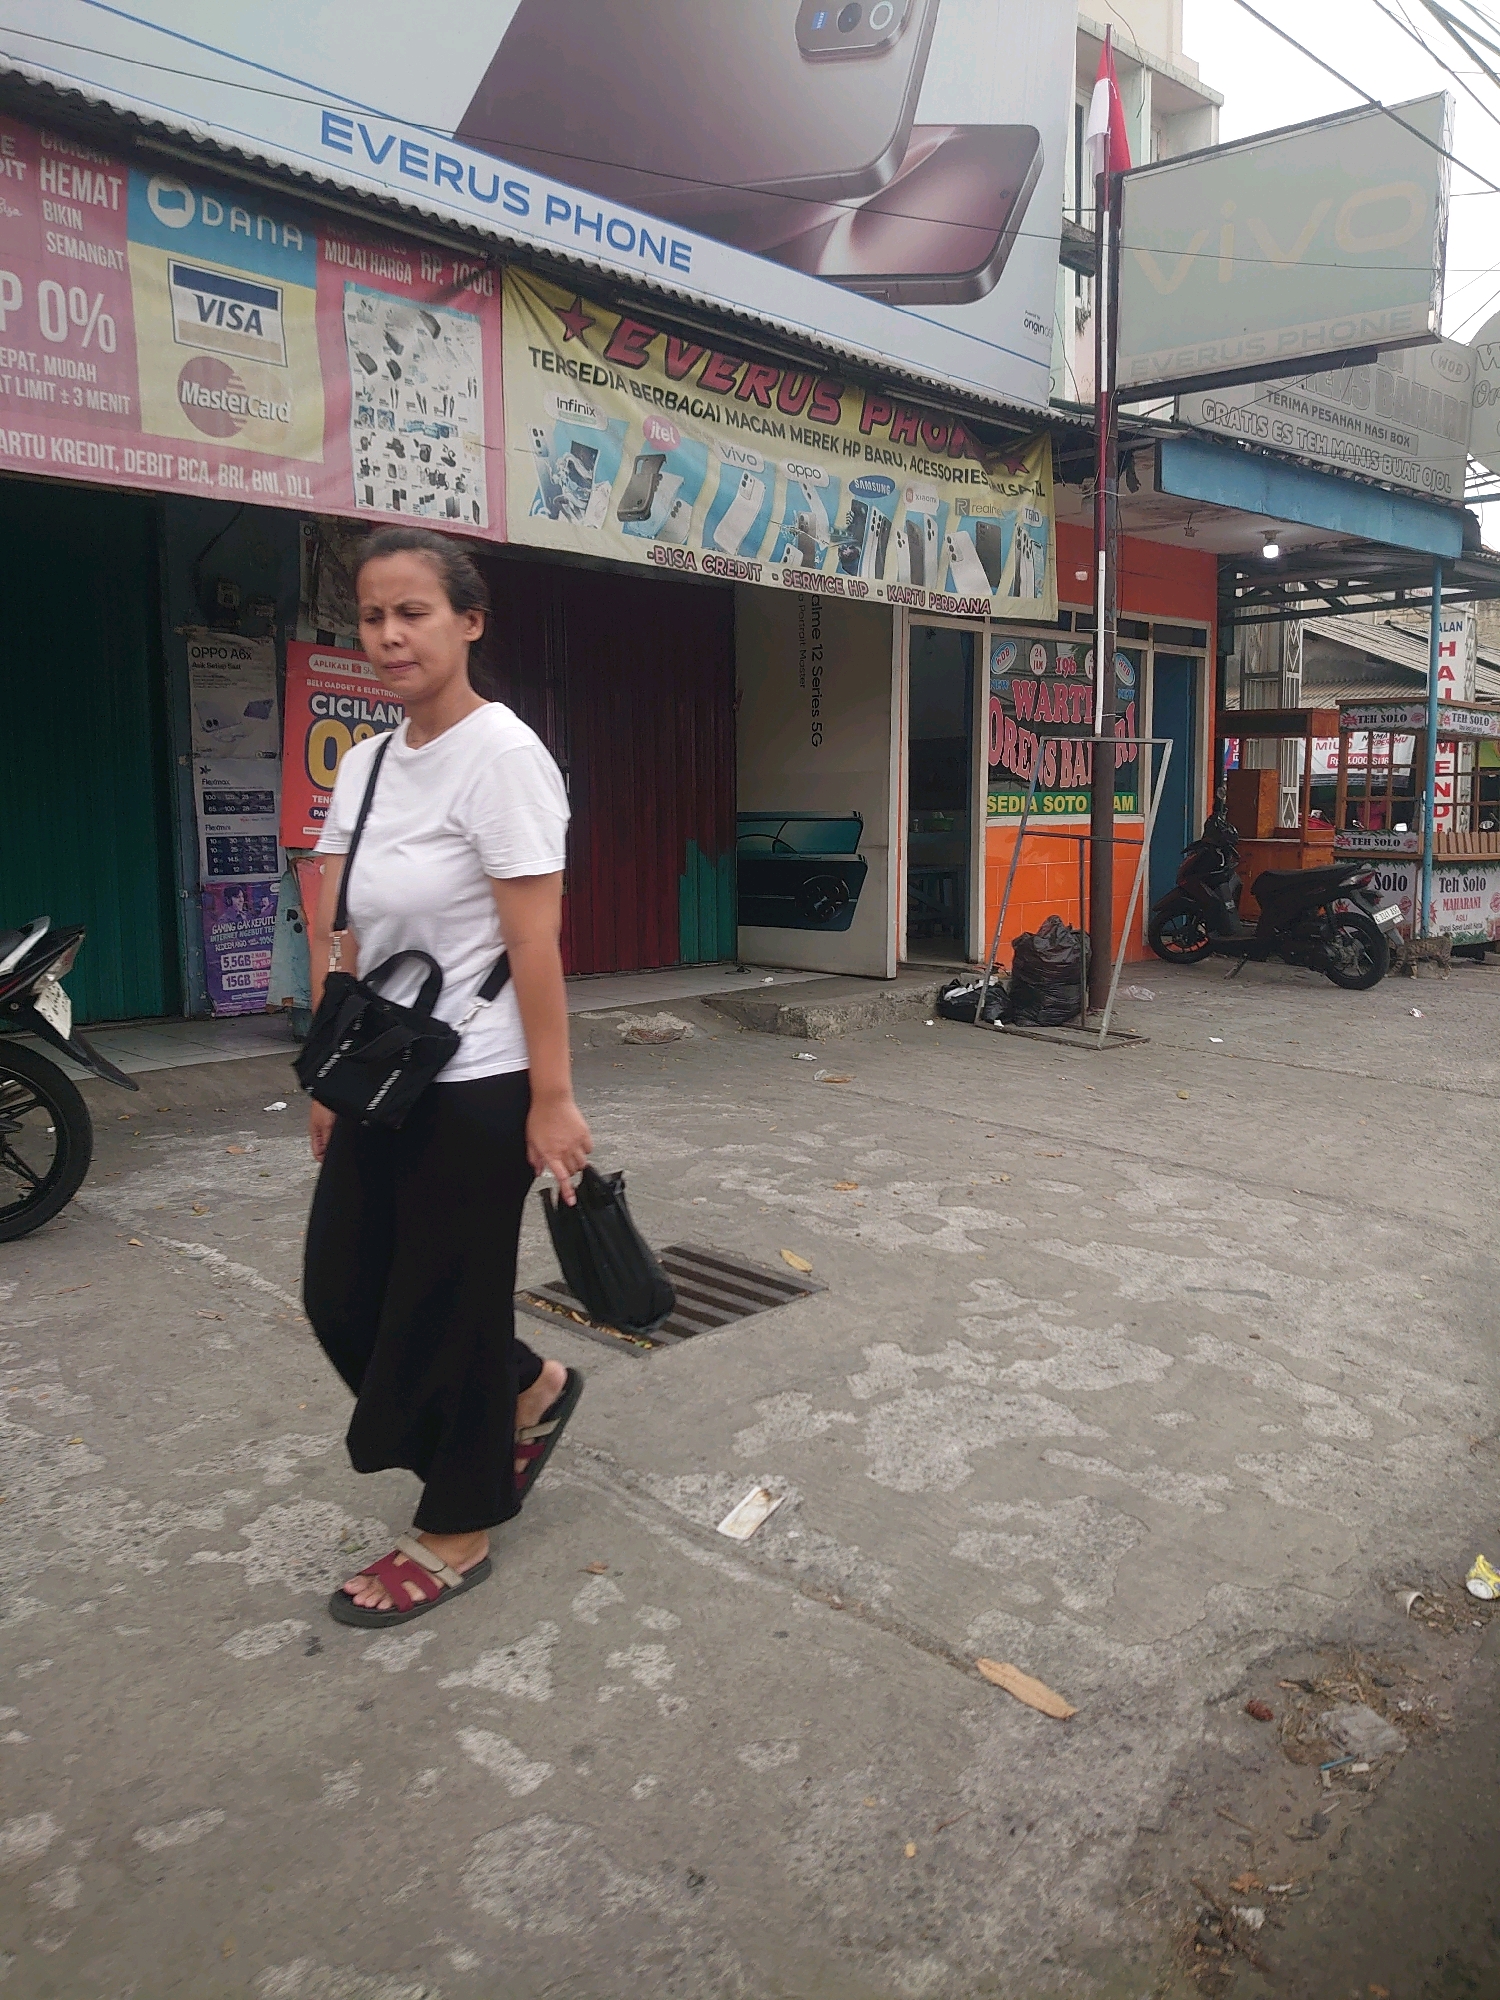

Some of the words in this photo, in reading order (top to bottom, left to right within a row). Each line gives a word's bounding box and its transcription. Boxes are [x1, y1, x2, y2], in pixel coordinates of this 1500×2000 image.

[39, 156, 122, 211] HEMAT
[321, 110, 530, 216] EVERUS
[545, 193, 692, 273] PHONE
[42, 200, 84, 231] BIKIN
[201, 195, 303, 251] DANA
[46, 231, 124, 272] SEMANGAT
[1132, 180, 1429, 295] vivo
[325, 239, 367, 272] MULAI
[370, 253, 412, 285] HARGA
[38, 279, 117, 353] 0%
[192, 293, 263, 337] VISA
[1129, 336, 1266, 379] EVERUS
[1277, 310, 1412, 353] PHONE
[44, 354, 97, 383] MUDAH
[603, 315, 845, 425] EVERUS
[15, 376, 57, 403] LIMIT
[73, 386, 84, 407] 3
[87, 389, 131, 415] MENIT
[181, 380, 291, 424] MasterCard
[528, 346, 628, 394] TERSEDIA
[629, 379, 721, 425] BERBAGAI
[724, 407, 786, 441] MACAM
[790, 424, 839, 453] MEREK
[843, 438, 861, 458] HP
[864, 445, 907, 472] BARU,
[651, 420, 676, 445] itel
[1266, 389, 1309, 414] TERIMA
[1389, 431, 1411, 449] BOX
[720, 445, 757, 466] vivo
[1201, 398, 1269, 438] GRATIS
[1271, 419, 1294, 445] ES
[1296, 427, 1329, 456] TEH
[1331, 437, 1380, 472] MANIS
[1381, 455, 1421, 486] BUAT
[1422, 466, 1452, 493] OJOL
[51, 436, 120, 474] KREDIT,
[124, 448, 175, 479] DEBIT
[178, 455, 215, 487] BCA,
[218, 463, 250, 492] BRI,
[252, 469, 285, 498] BNI,
[286, 473, 315, 500] DLL
[787, 462, 821, 480] oppo
[853, 479, 892, 495] SAMSUNG
[702, 555, 762, 581] CREDIT
[782, 568, 845, 595] SERVICE
[848, 579, 869, 598] HP
[887, 584, 926, 606] KARTU
[928, 592, 992, 615] PERDANA
[191, 646, 228, 659] OPPO
[314, 659, 350, 671] APLIKASI
[812, 643, 823, 661] 12
[306, 678, 323, 687] BELI
[324, 681, 356, 691] GADGET
[811, 666, 823, 718] Series
[311, 694, 403, 725] CICILAN
[1358, 713, 1377, 724] TEH
[1380, 713, 1408, 724] SOLO
[1452, 712, 1469, 724] TEH
[1470, 715, 1490, 727] SOLO
[811, 721, 823, 748] 5G
[987, 795, 1038, 813] SEDIA
[1043, 795, 1087, 813] SOTO
[1351, 837, 1371, 846] TEH
[1374, 837, 1401, 847] SOLO
[1374, 872, 1408, 892] Solo
[1439, 877, 1460, 893] Teh
[1462, 876, 1486, 891] Solo
[1442, 897, 1481, 911] MAHARANI
[226, 974, 251, 988] 15GB
